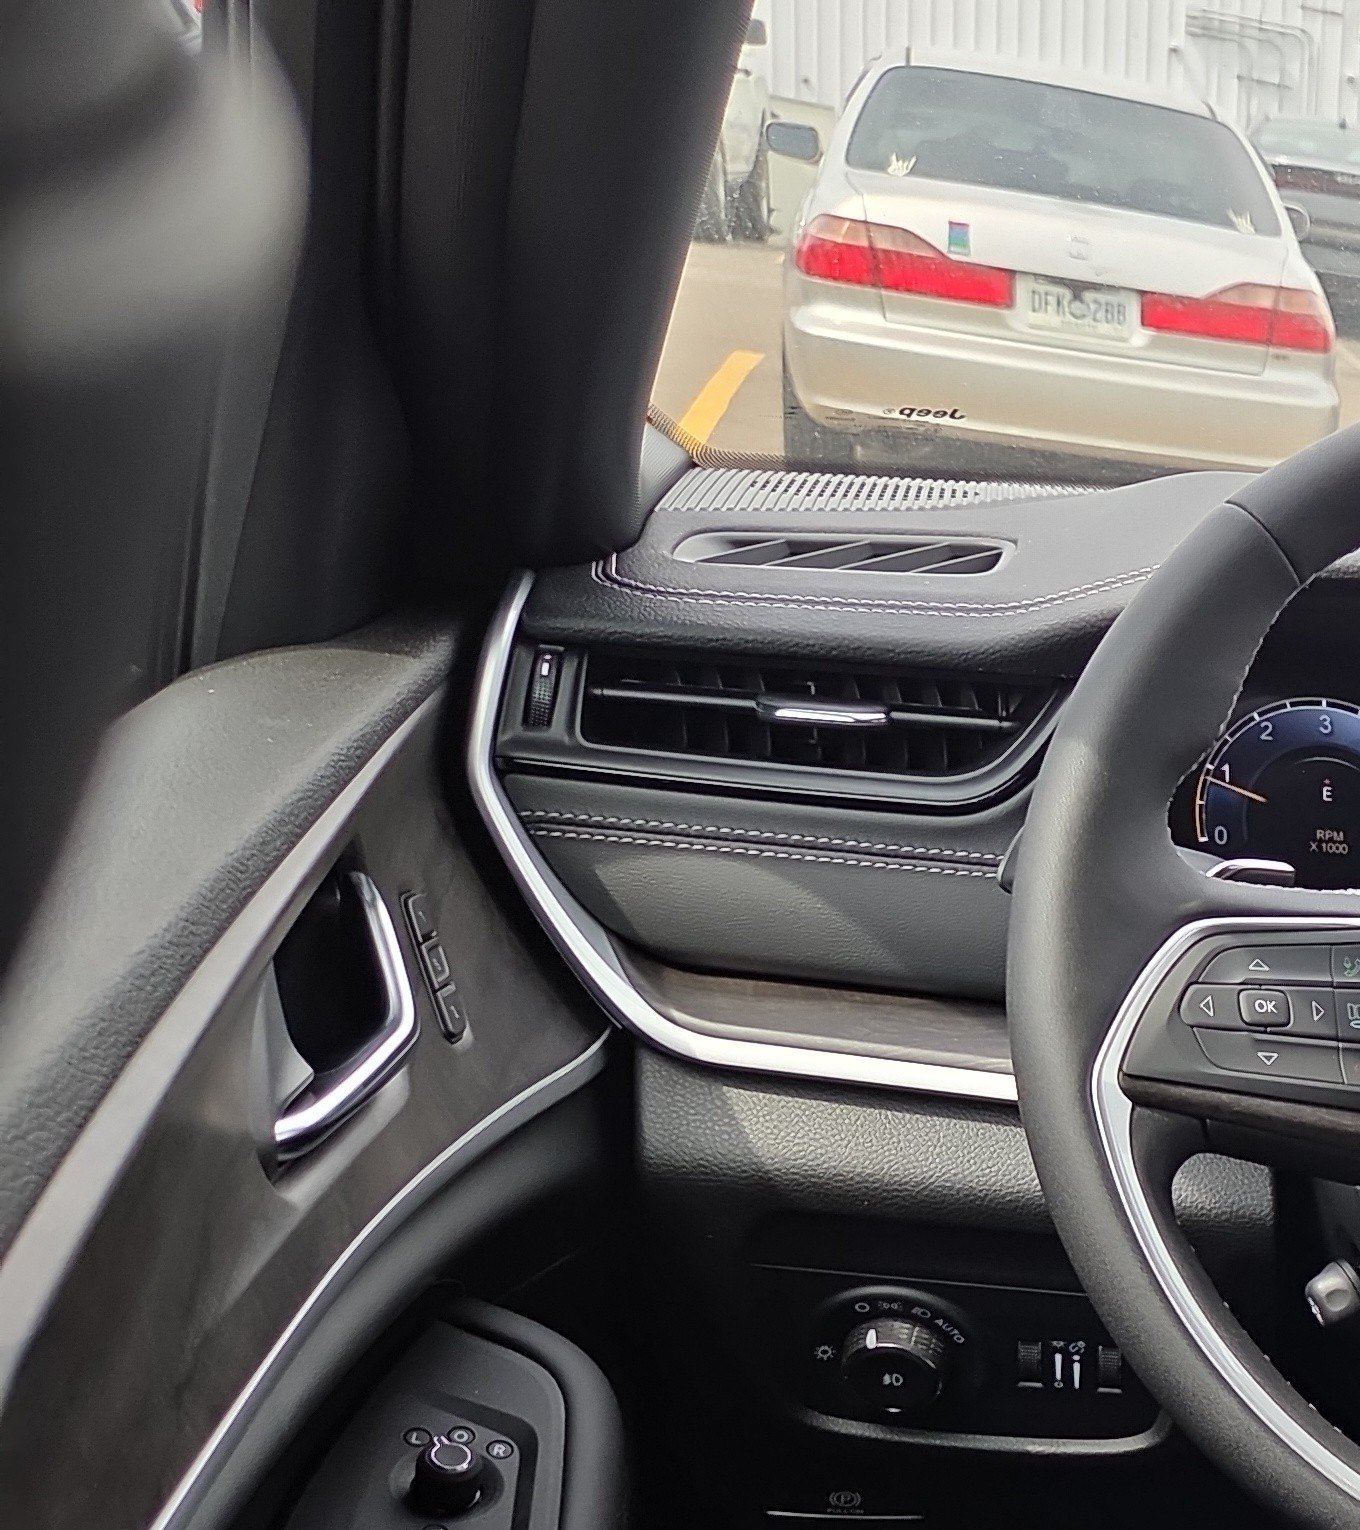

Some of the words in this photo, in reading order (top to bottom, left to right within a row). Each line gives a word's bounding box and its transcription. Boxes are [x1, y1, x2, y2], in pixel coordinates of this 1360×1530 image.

[1260, 722, 1274, 741] 2
[1319, 715, 1333, 734] 3
[1221, 763, 1230, 782] 1
[1323, 786, 1333, 801] E
[1214, 826, 1227, 844] 0
[1316, 829, 1344, 842] RPM
[1322, 842, 1348, 855] 1000
[1254, 999, 1278, 1013] OK
[934, 1318, 965, 1344] AUTO
[412, 1432, 422, 1445] L
